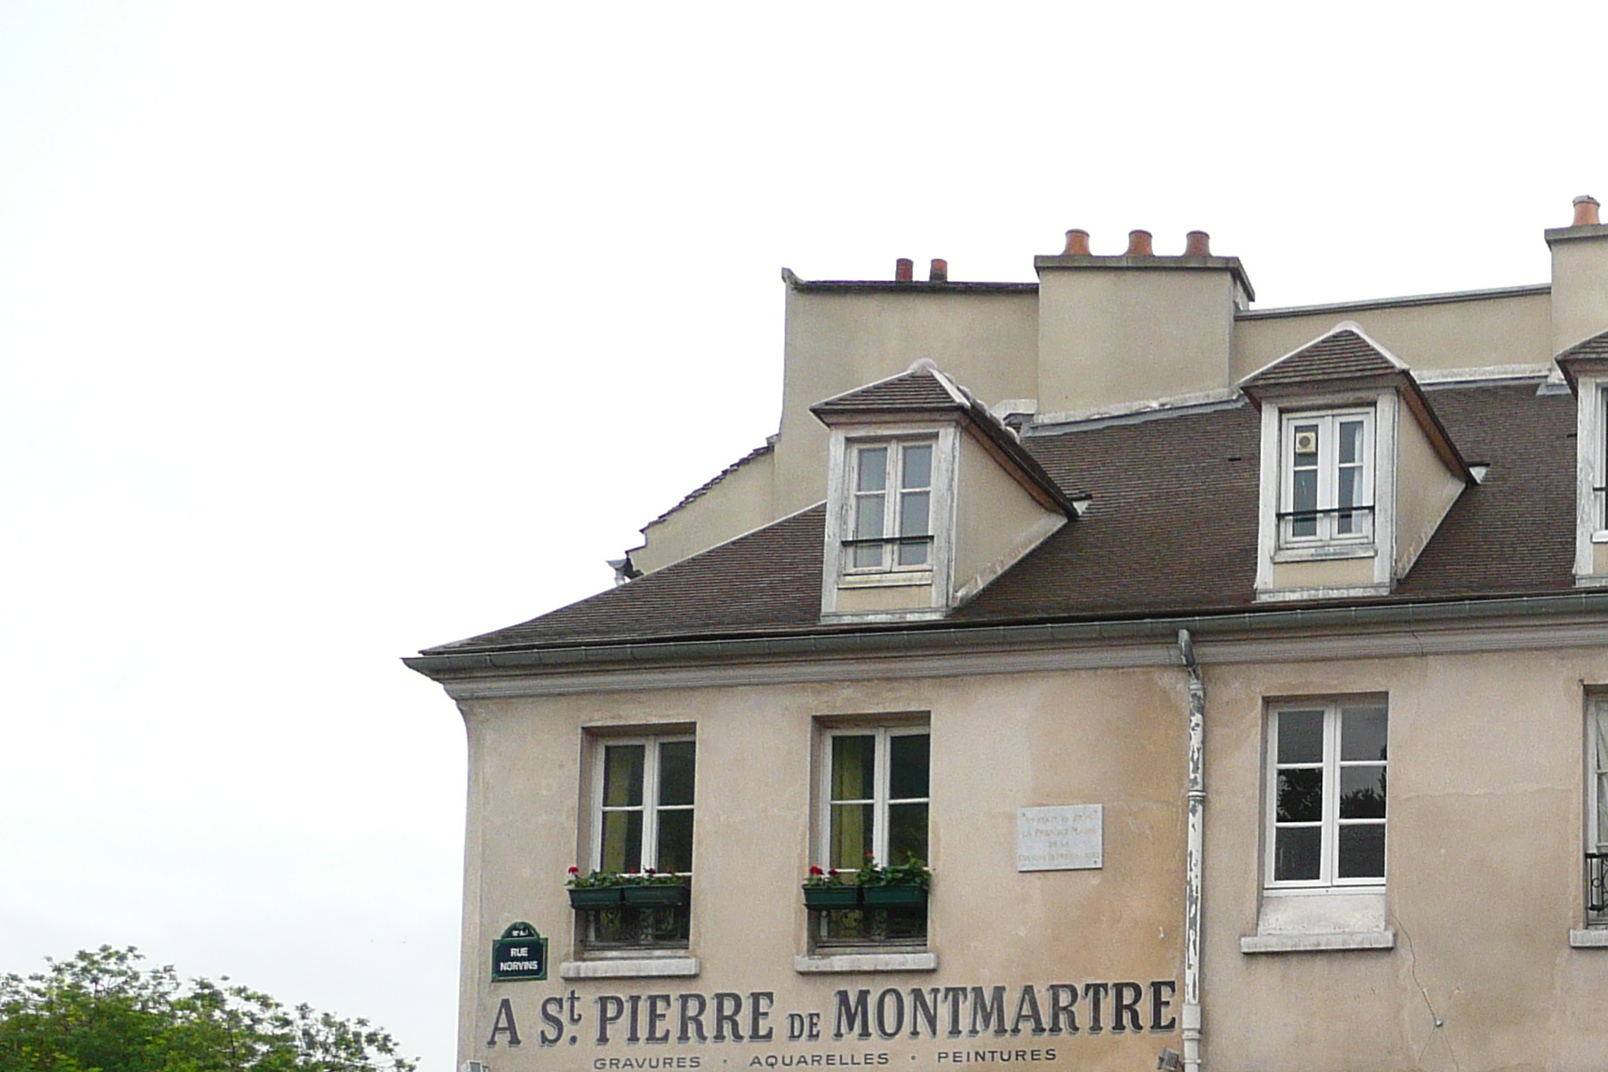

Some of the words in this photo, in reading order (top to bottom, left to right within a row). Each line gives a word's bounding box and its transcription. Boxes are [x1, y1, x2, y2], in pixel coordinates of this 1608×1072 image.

[510, 947, 529, 957] RUE
[500, 961, 538, 971] NORVINS
[487, 998, 522, 1047] A
[596, 991, 775, 1046] PIERRE
[788, 1012, 821, 1041] DE
[834, 980, 1178, 1041] MONTMARTRE
[593, 1055, 701, 1070] GRAVURES
[749, 1053, 889, 1068] AQUARELLES
[937, 1048, 1057, 1064] PEINTURES
